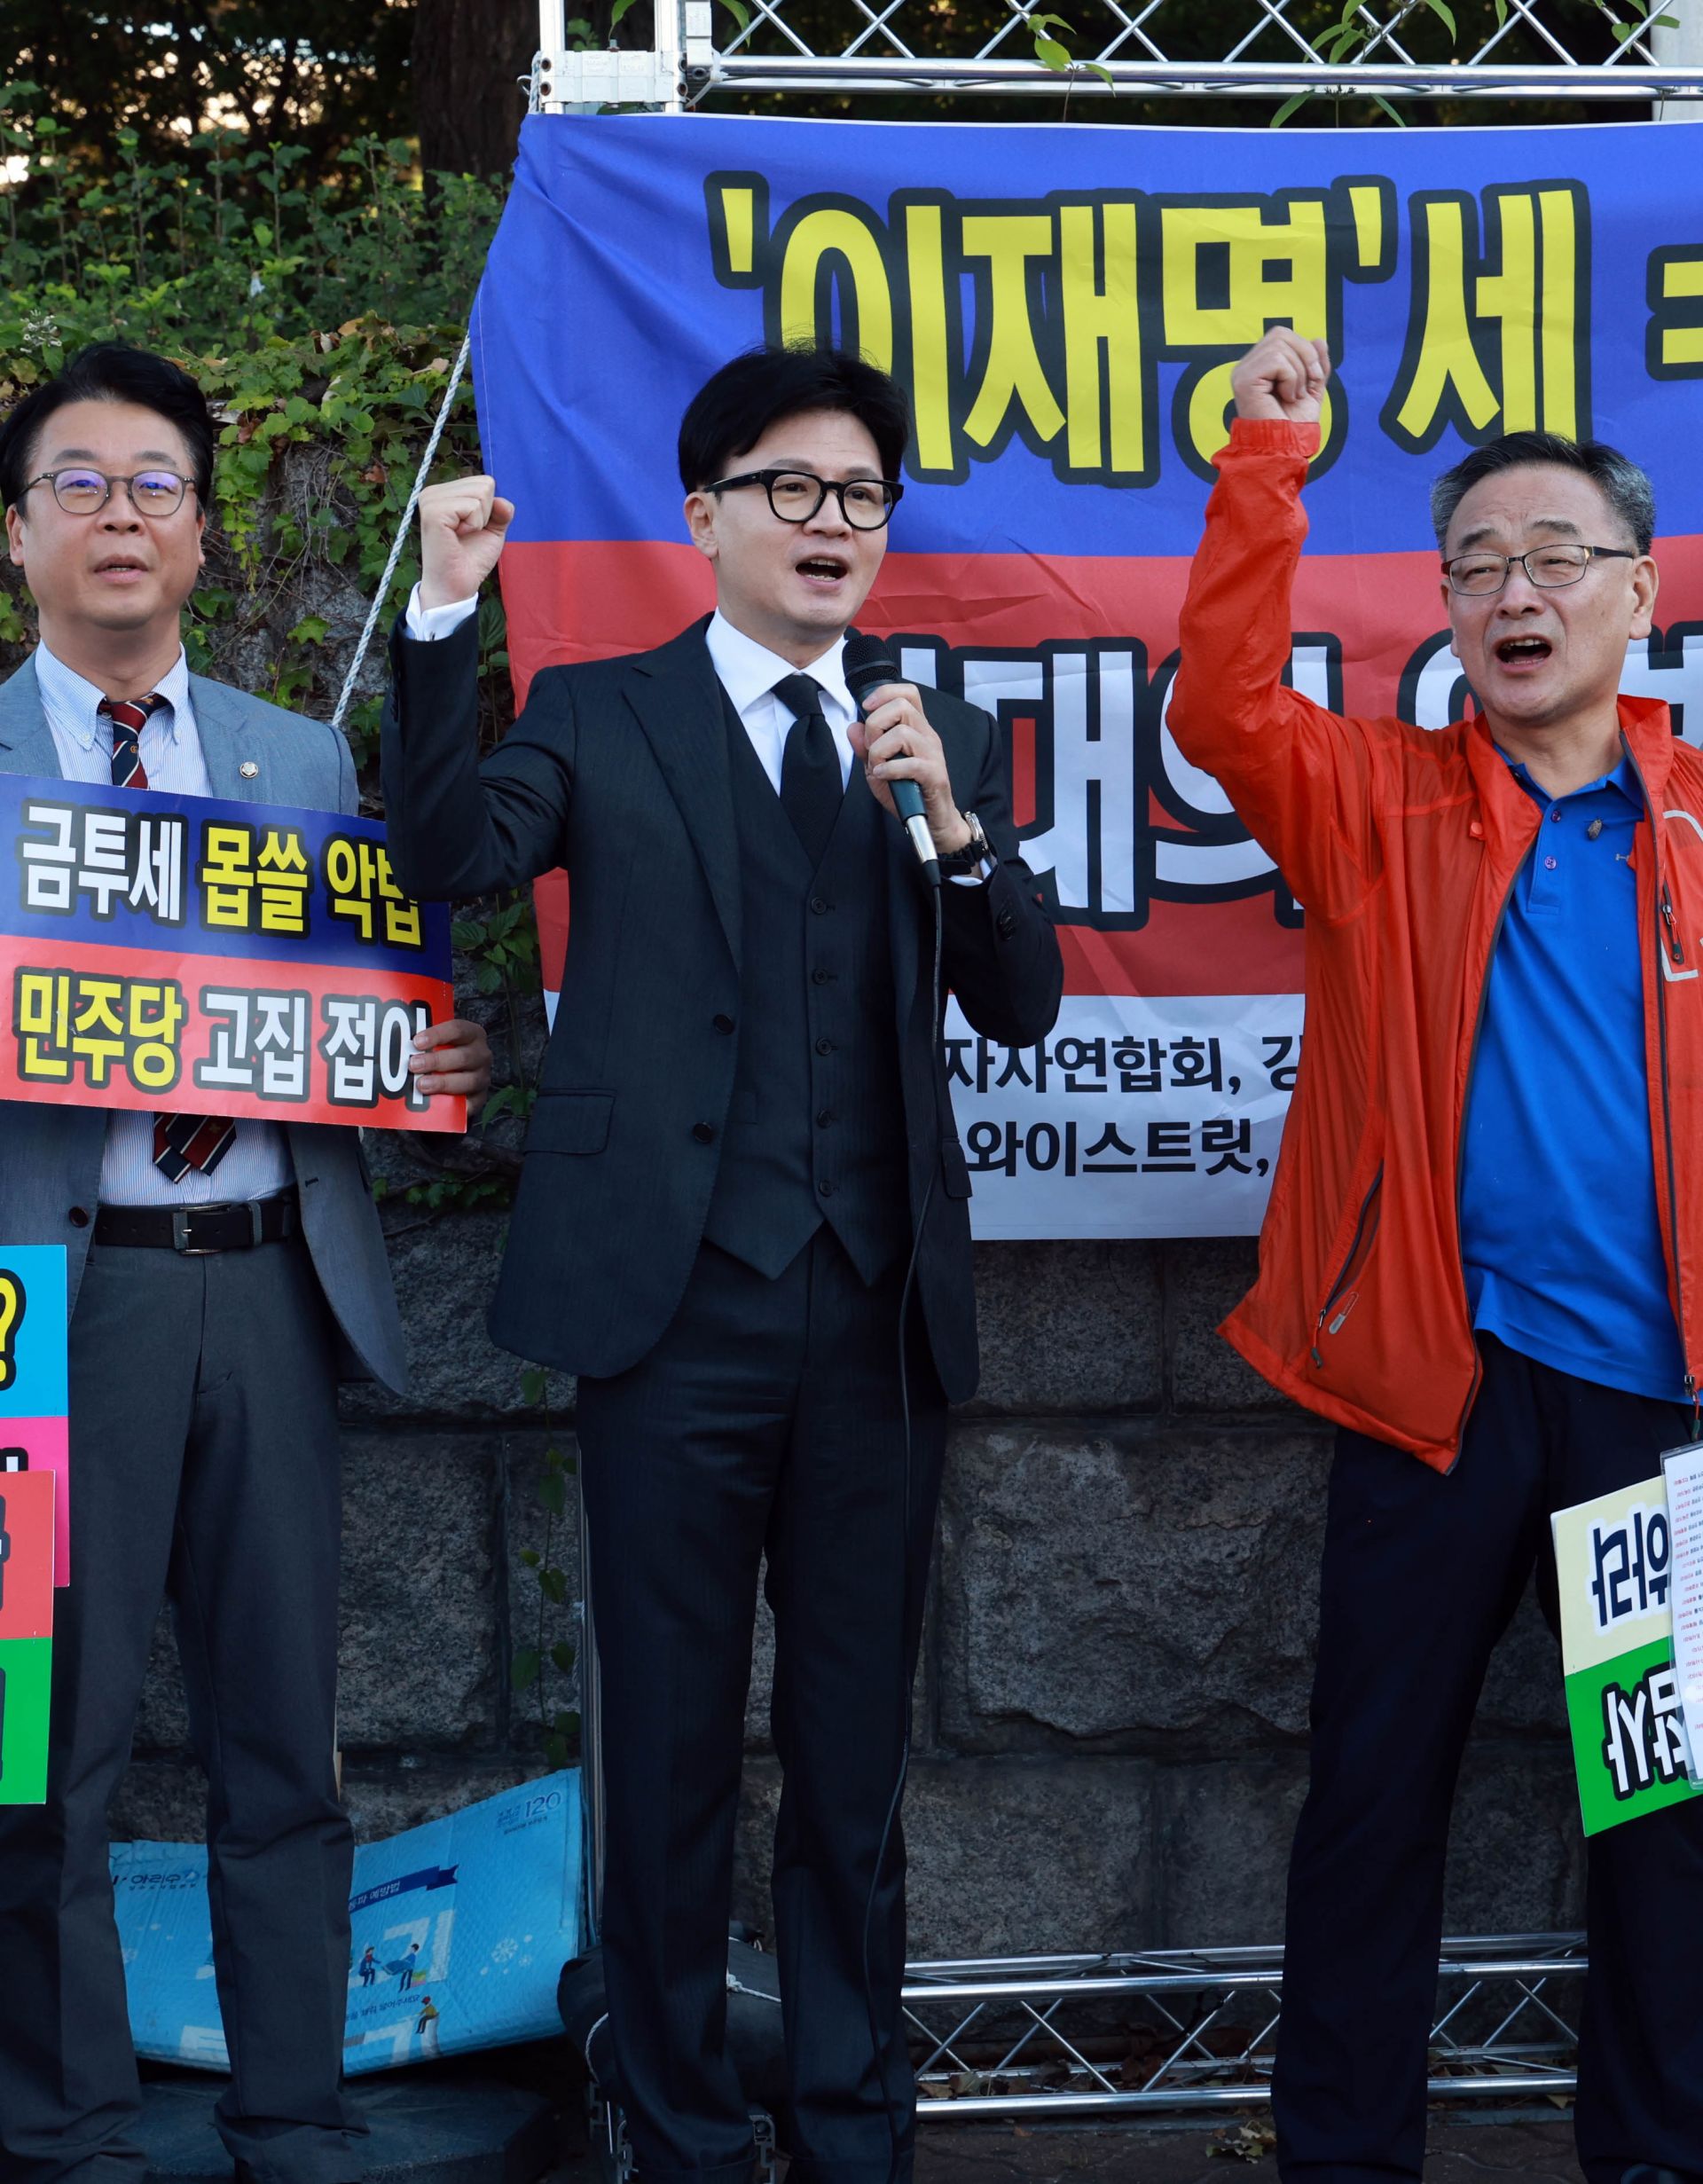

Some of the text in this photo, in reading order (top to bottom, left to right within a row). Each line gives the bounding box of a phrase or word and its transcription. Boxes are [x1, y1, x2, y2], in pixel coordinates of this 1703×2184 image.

[721, 186, 1577, 472] '이재명'세
[23, 805, 183, 921] 금투세
[202, 826, 309, 932] 몹쓸
[20, 974, 427, 1104] 민주당 고집 접어
[967, 1118, 1269, 1177] 와이스트릿,
[1592, 1512, 1670, 1627] 하라
[525, 1791, 562, 1818] 120
[130, 1872, 181, 1884] 아리수
